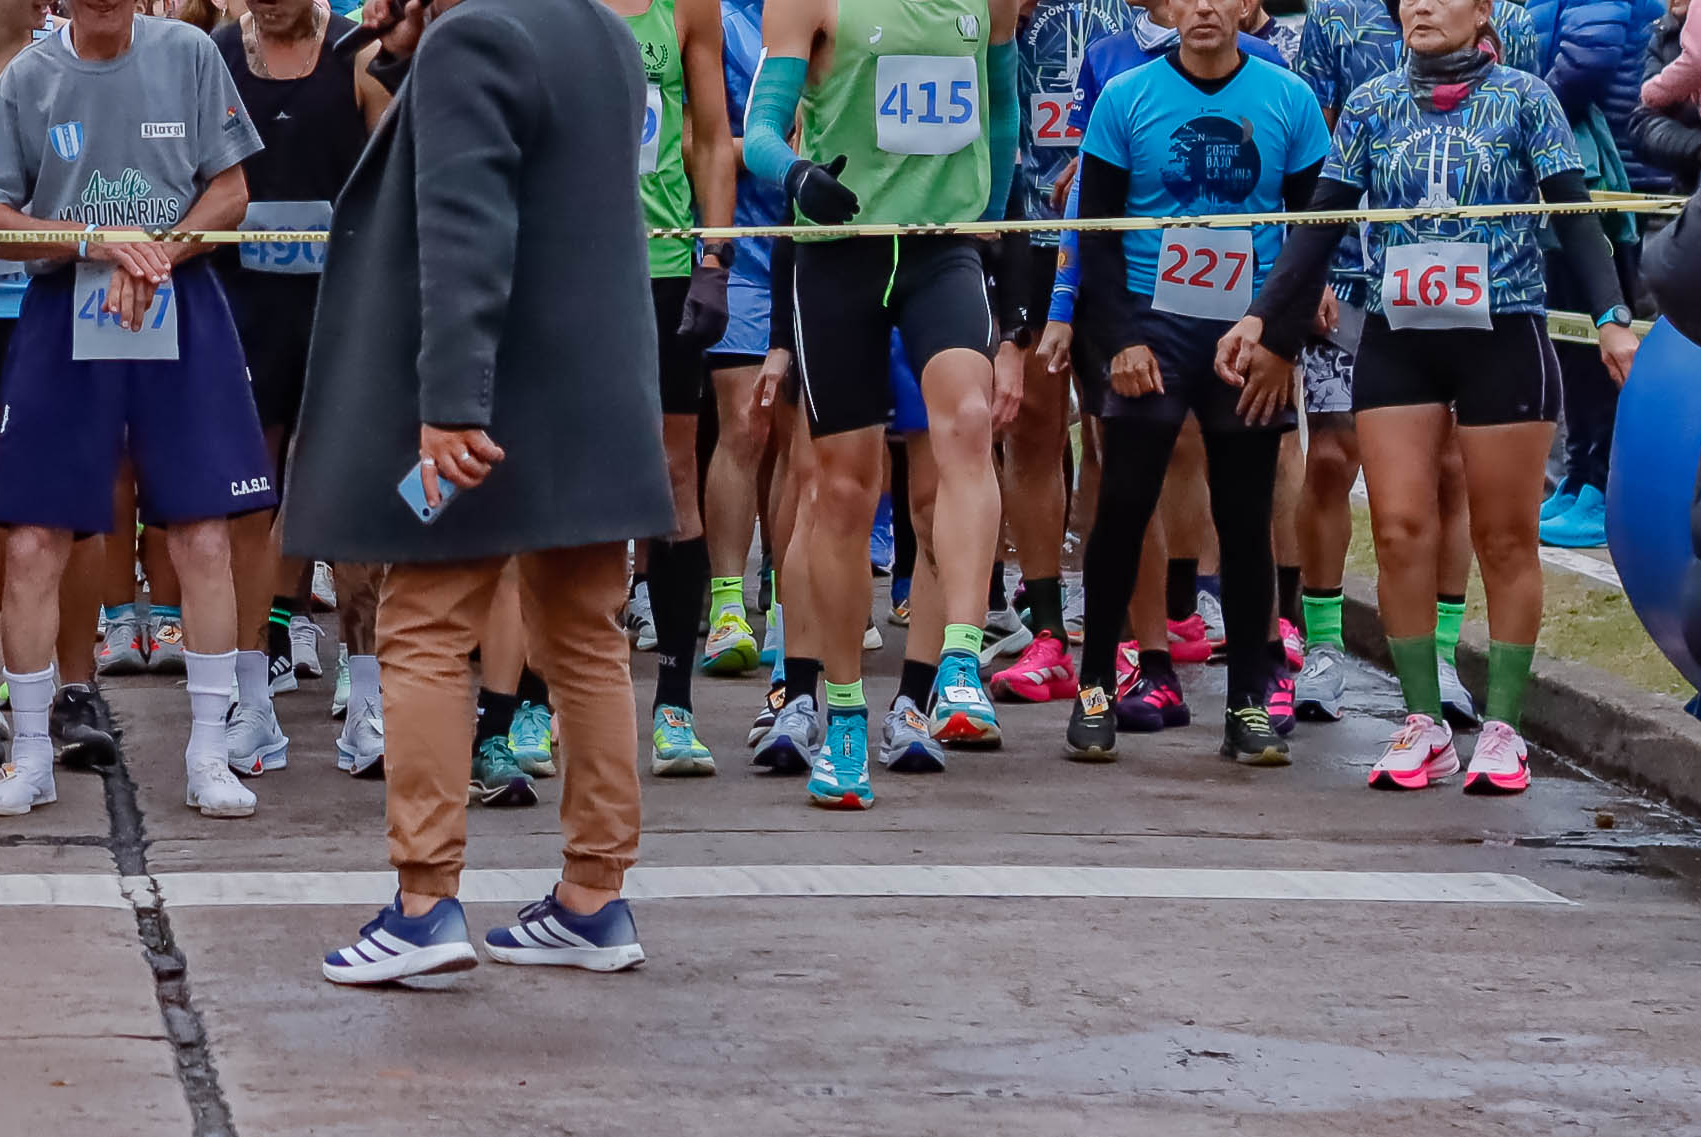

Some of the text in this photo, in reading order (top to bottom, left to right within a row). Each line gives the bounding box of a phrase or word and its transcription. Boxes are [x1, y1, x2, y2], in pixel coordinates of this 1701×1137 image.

[880, 80, 973, 124] 415
[1206, 144, 1240, 156] CORRE
[1206, 156, 1231, 168] BAJO
[59, 196, 179, 226] MAQUINARIAS
[1162, 244, 1247, 291] 227
[1392, 265, 1482, 307] 165
[78, 288, 172, 330] 47
[231, 476, 270, 496] C.A.S.D.
